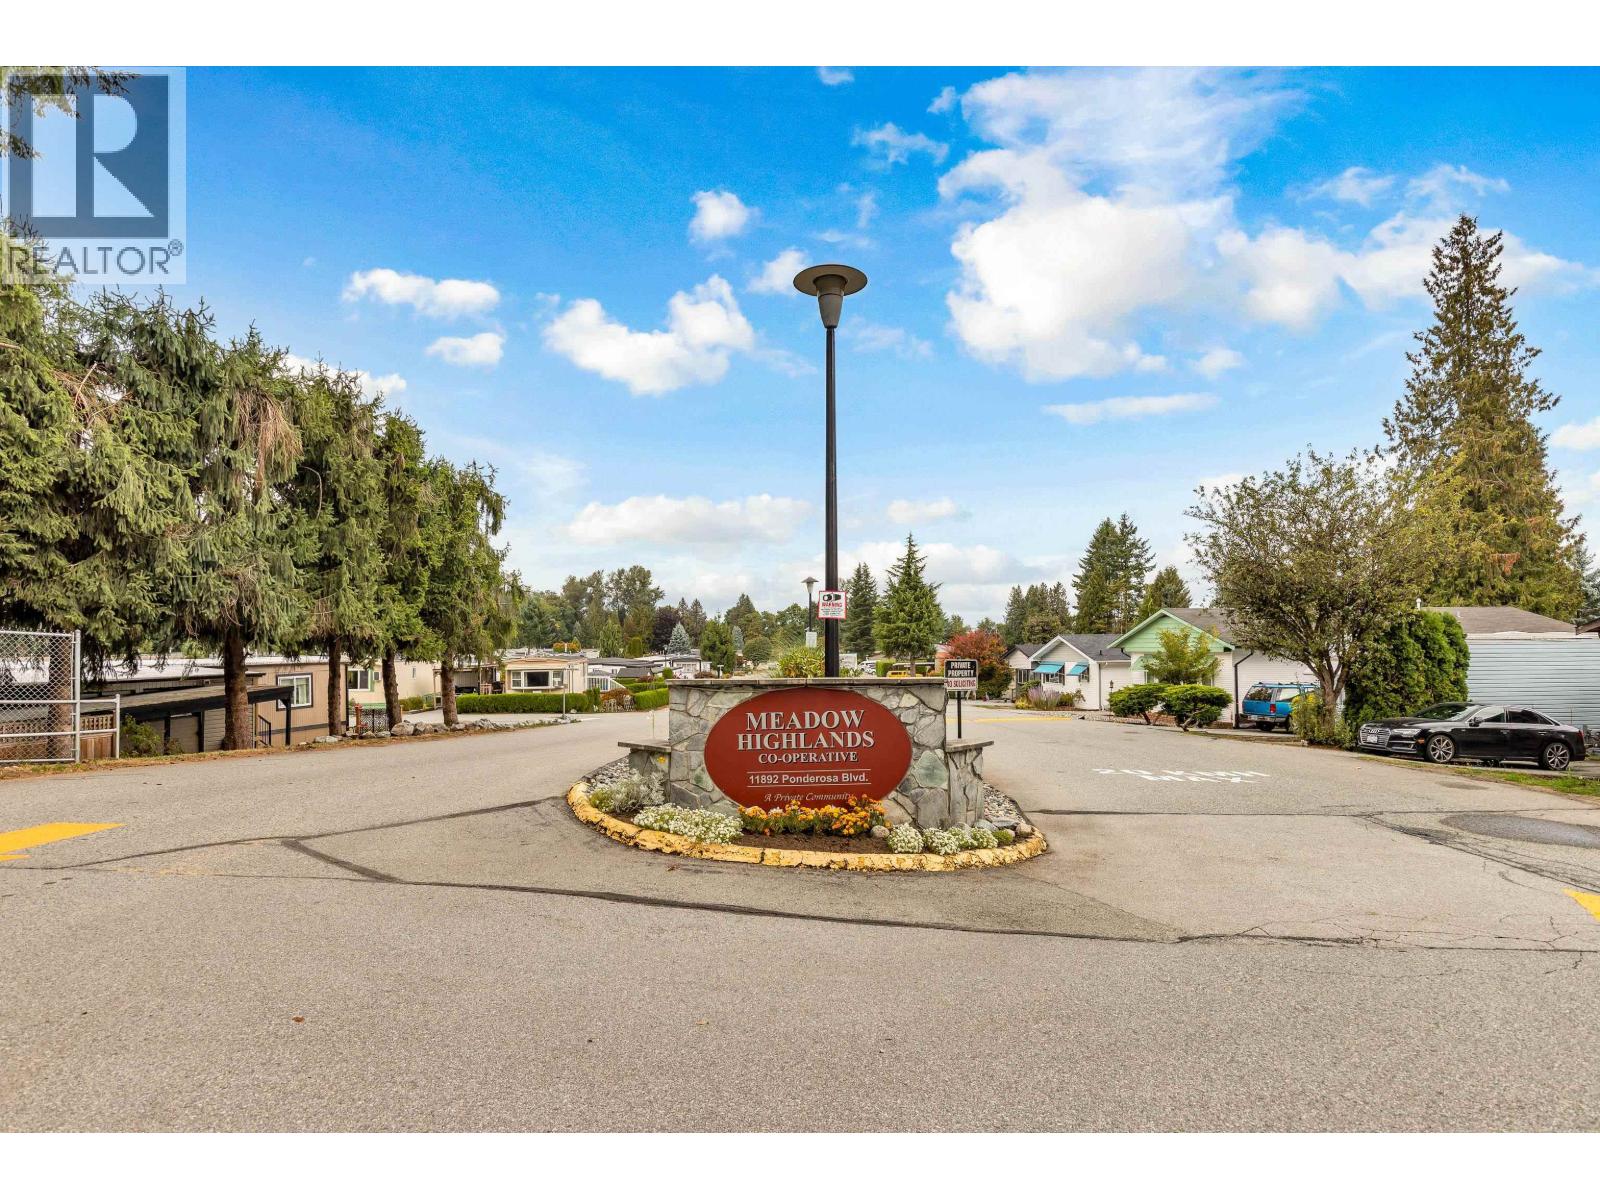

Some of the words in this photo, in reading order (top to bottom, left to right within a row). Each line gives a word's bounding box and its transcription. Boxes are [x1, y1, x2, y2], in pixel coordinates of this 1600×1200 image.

[950, 661, 971, 669] PRIVATE
[947, 669, 974, 677] PROPERTY
[745, 709, 865, 731] MEADOW
[736, 730, 875, 751] HIGHLANDS
[758, 751, 859, 765] CO-OPERATIVE
[748, 774, 779, 785] 11892
[781, 772, 839, 784] Ponderosa
[841, 771, 869, 783] Blvd.
[763, 793, 772, 802] A
[774, 792, 804, 802] Private
[805, 791, 850, 802] Communit
